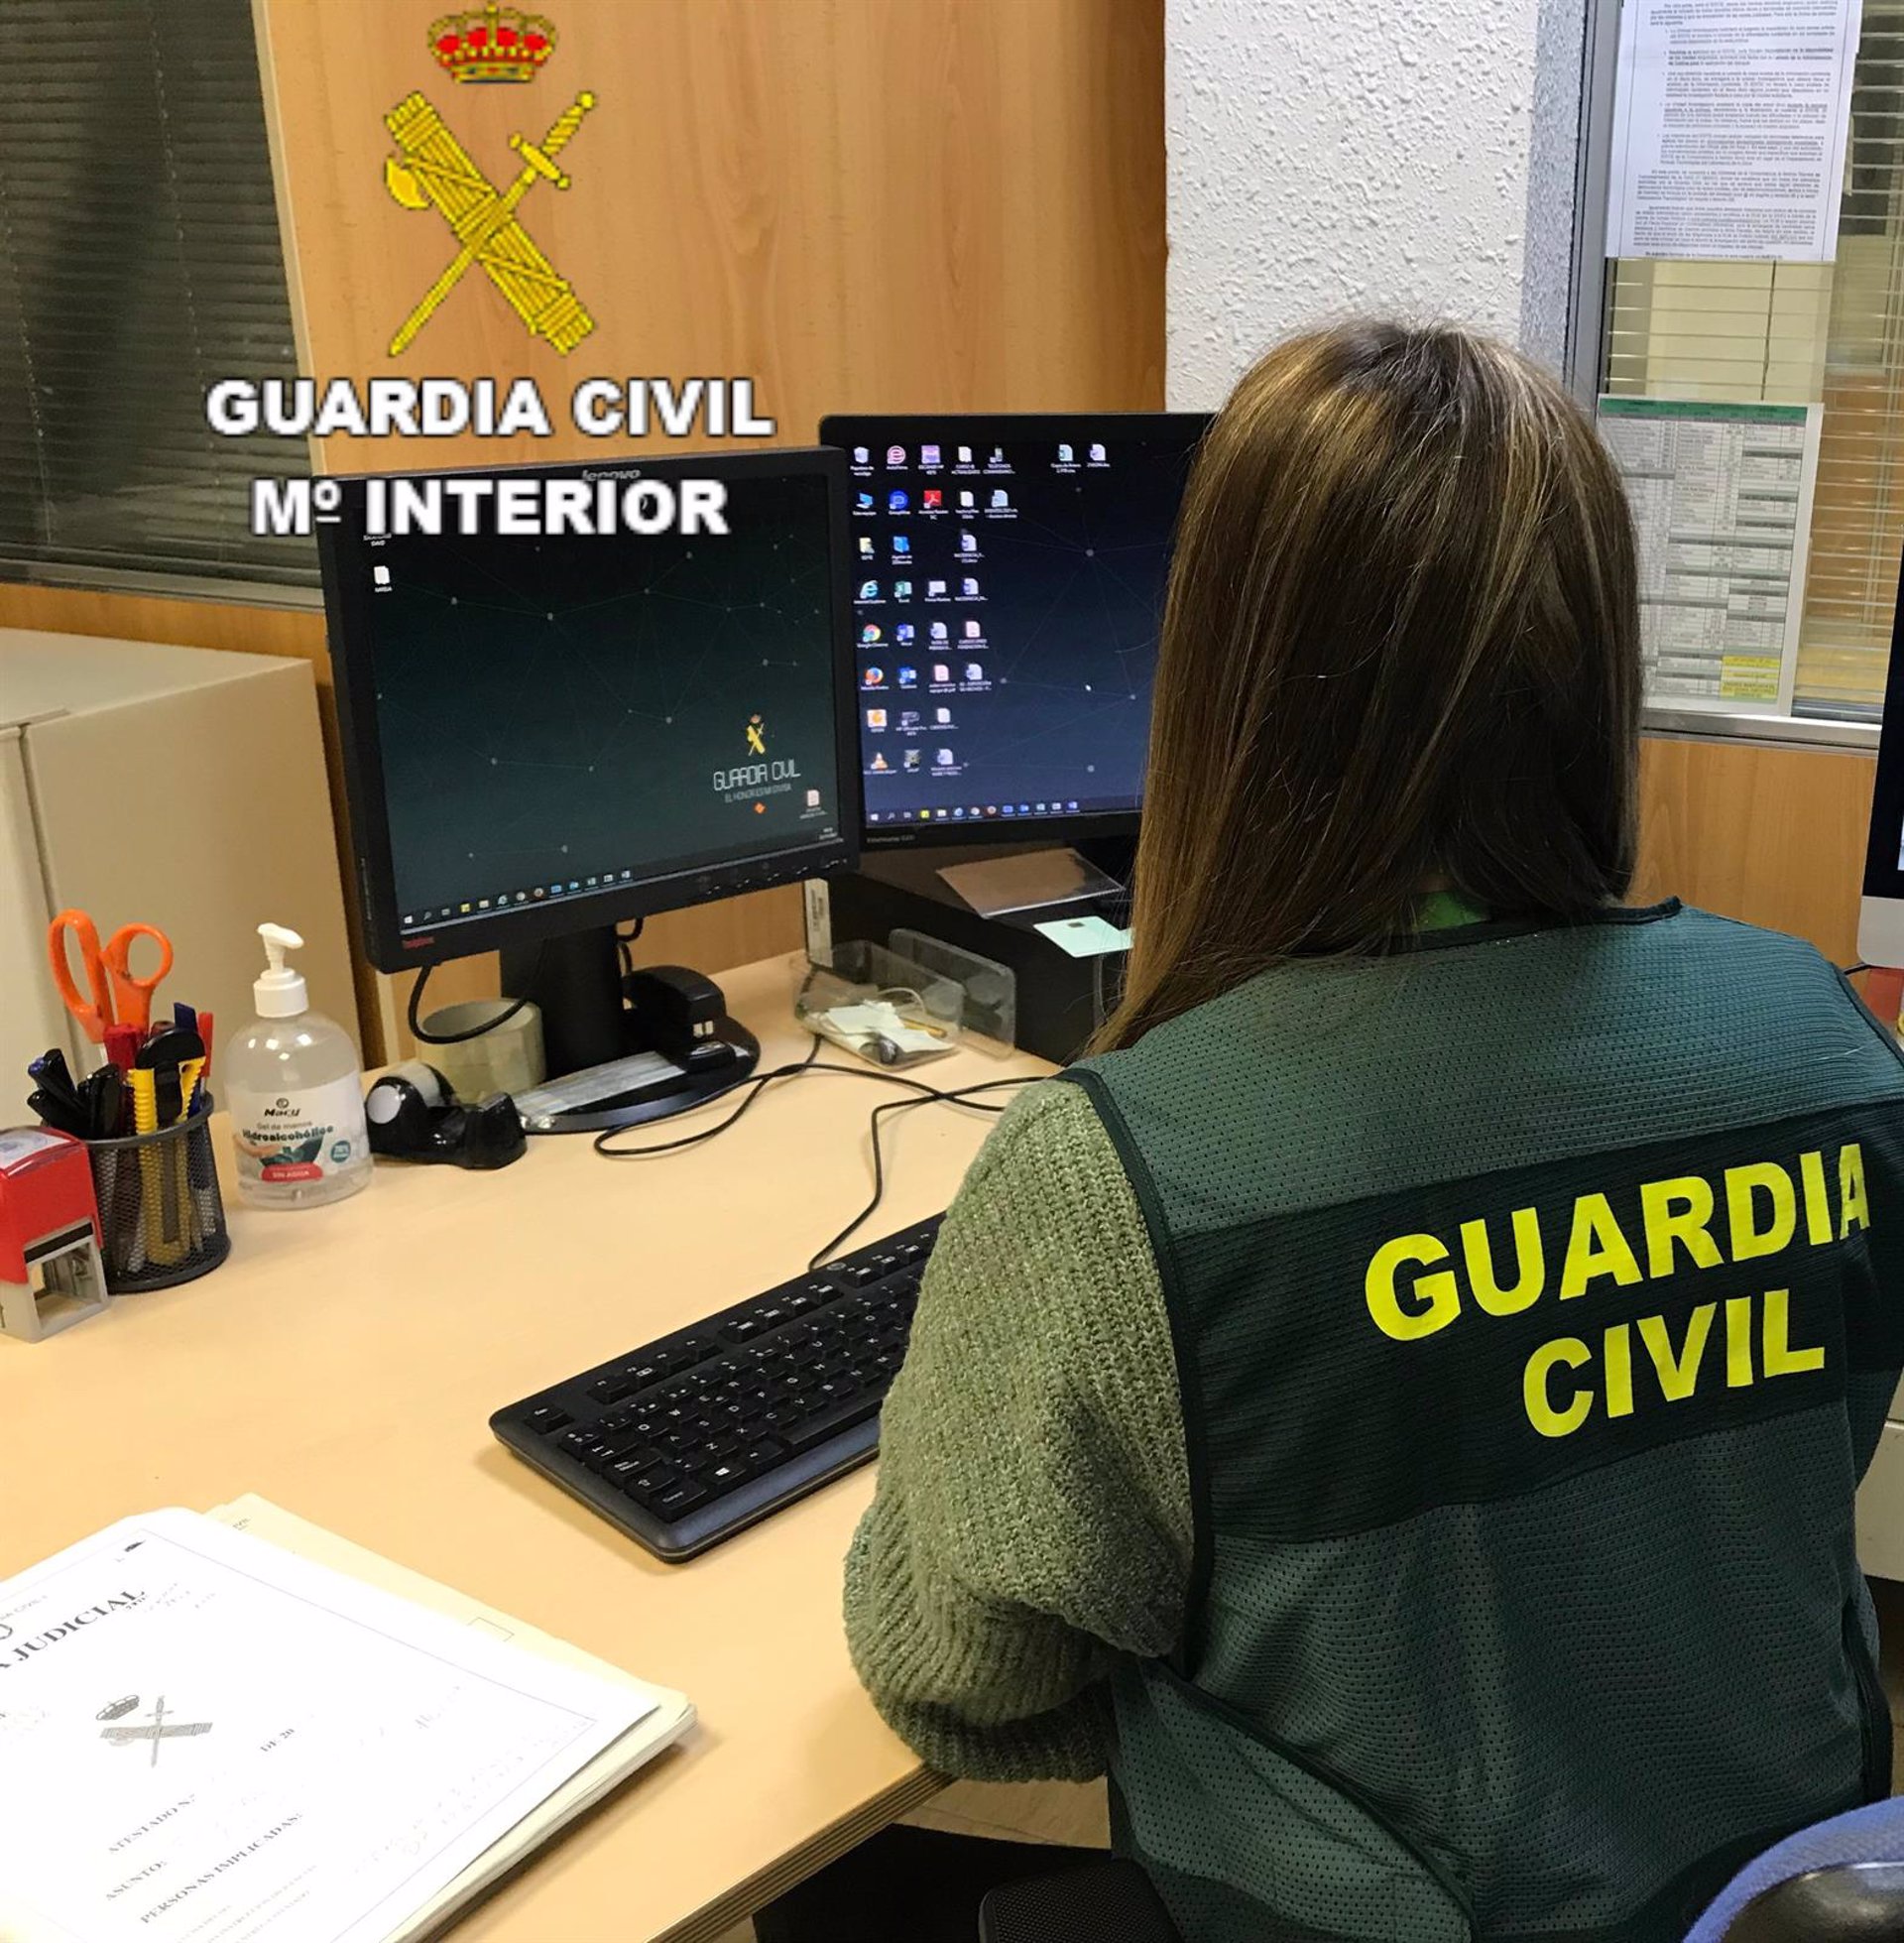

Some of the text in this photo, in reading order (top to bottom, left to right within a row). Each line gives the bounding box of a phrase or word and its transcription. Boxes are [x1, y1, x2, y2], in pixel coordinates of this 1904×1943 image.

[713, 763, 769, 791] GUARDIA
[1365, 1143, 1870, 1341] GUARDIA
[1523, 1288, 1825, 1437] CIVIL
[12, 1591, 146, 1662] JUDICIAL
[140, 1873, 215, 1924] PERSONAS
